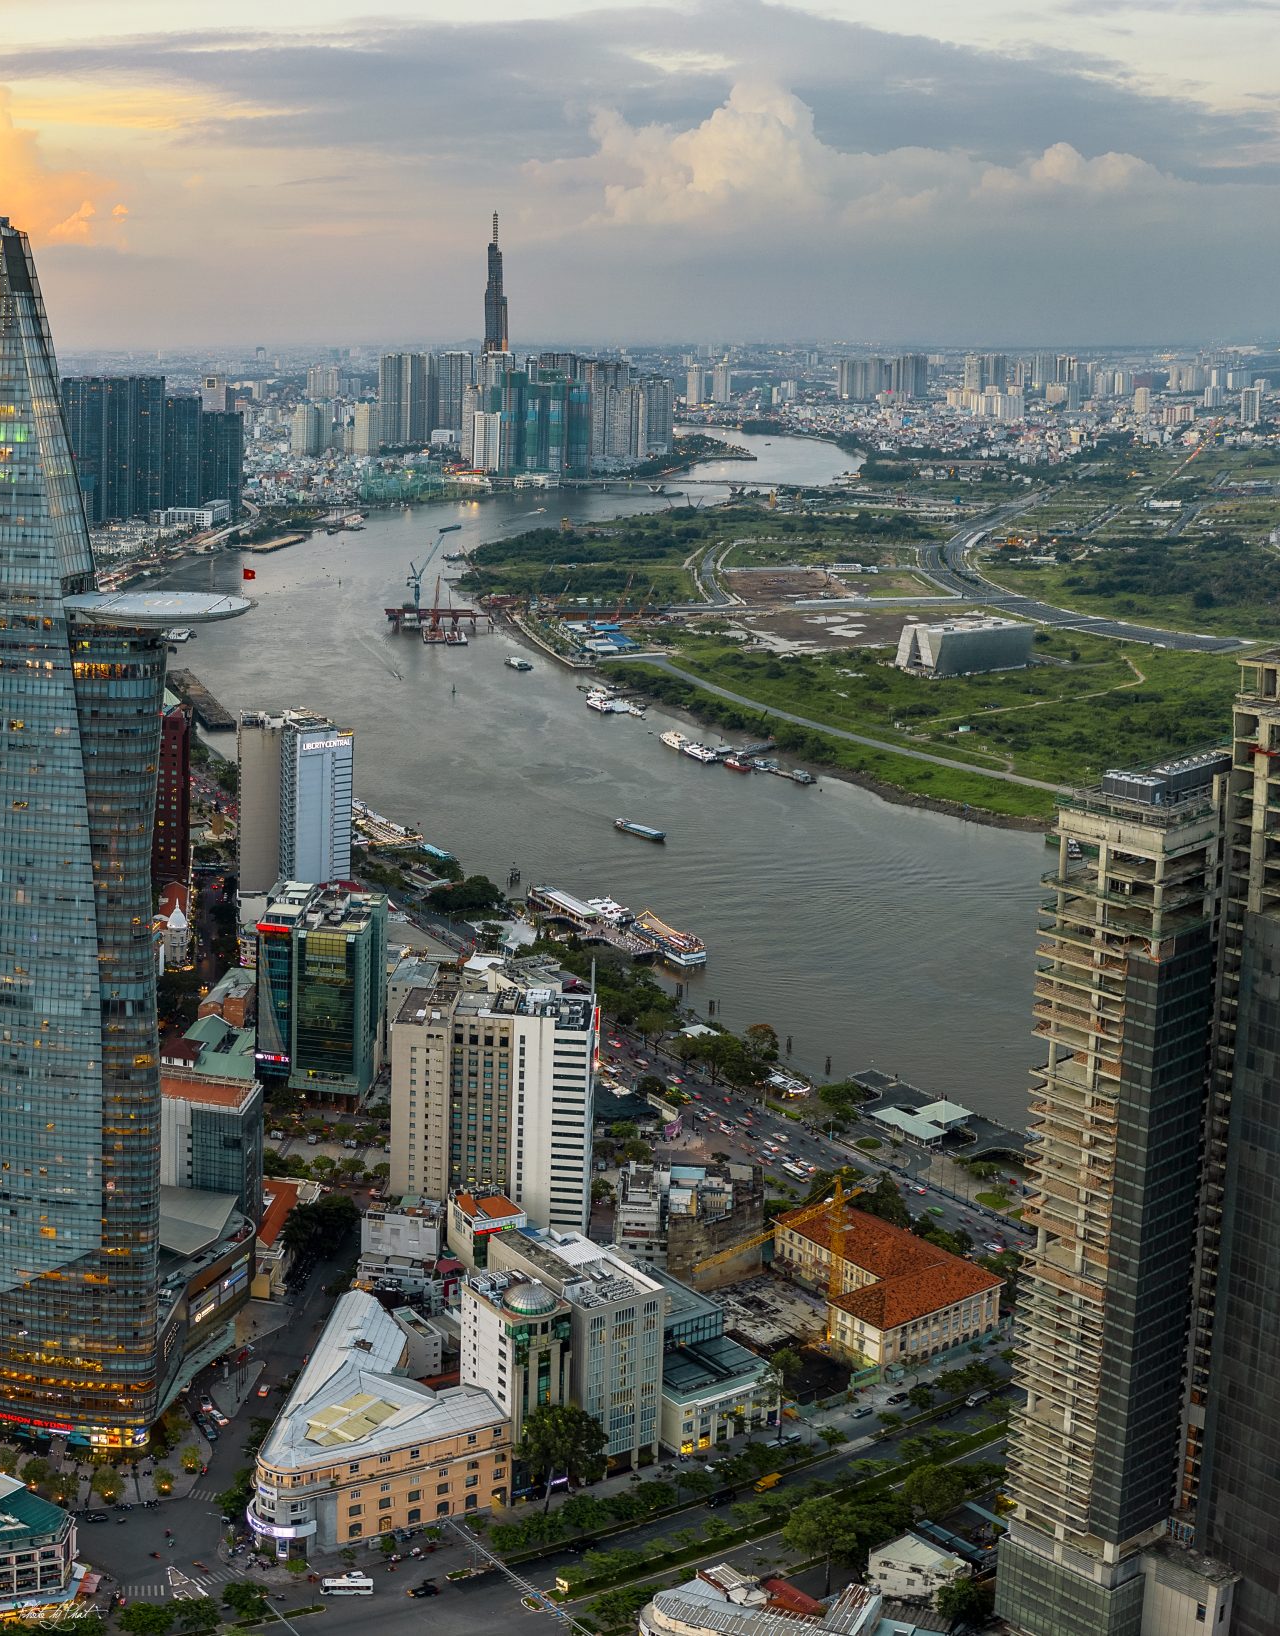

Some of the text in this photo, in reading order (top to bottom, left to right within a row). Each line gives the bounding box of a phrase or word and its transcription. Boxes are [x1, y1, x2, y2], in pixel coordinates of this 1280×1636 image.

[303, 738, 351, 751] LIBERTY CENTRAL
[33, 1419, 75, 1431] SKYDECK
